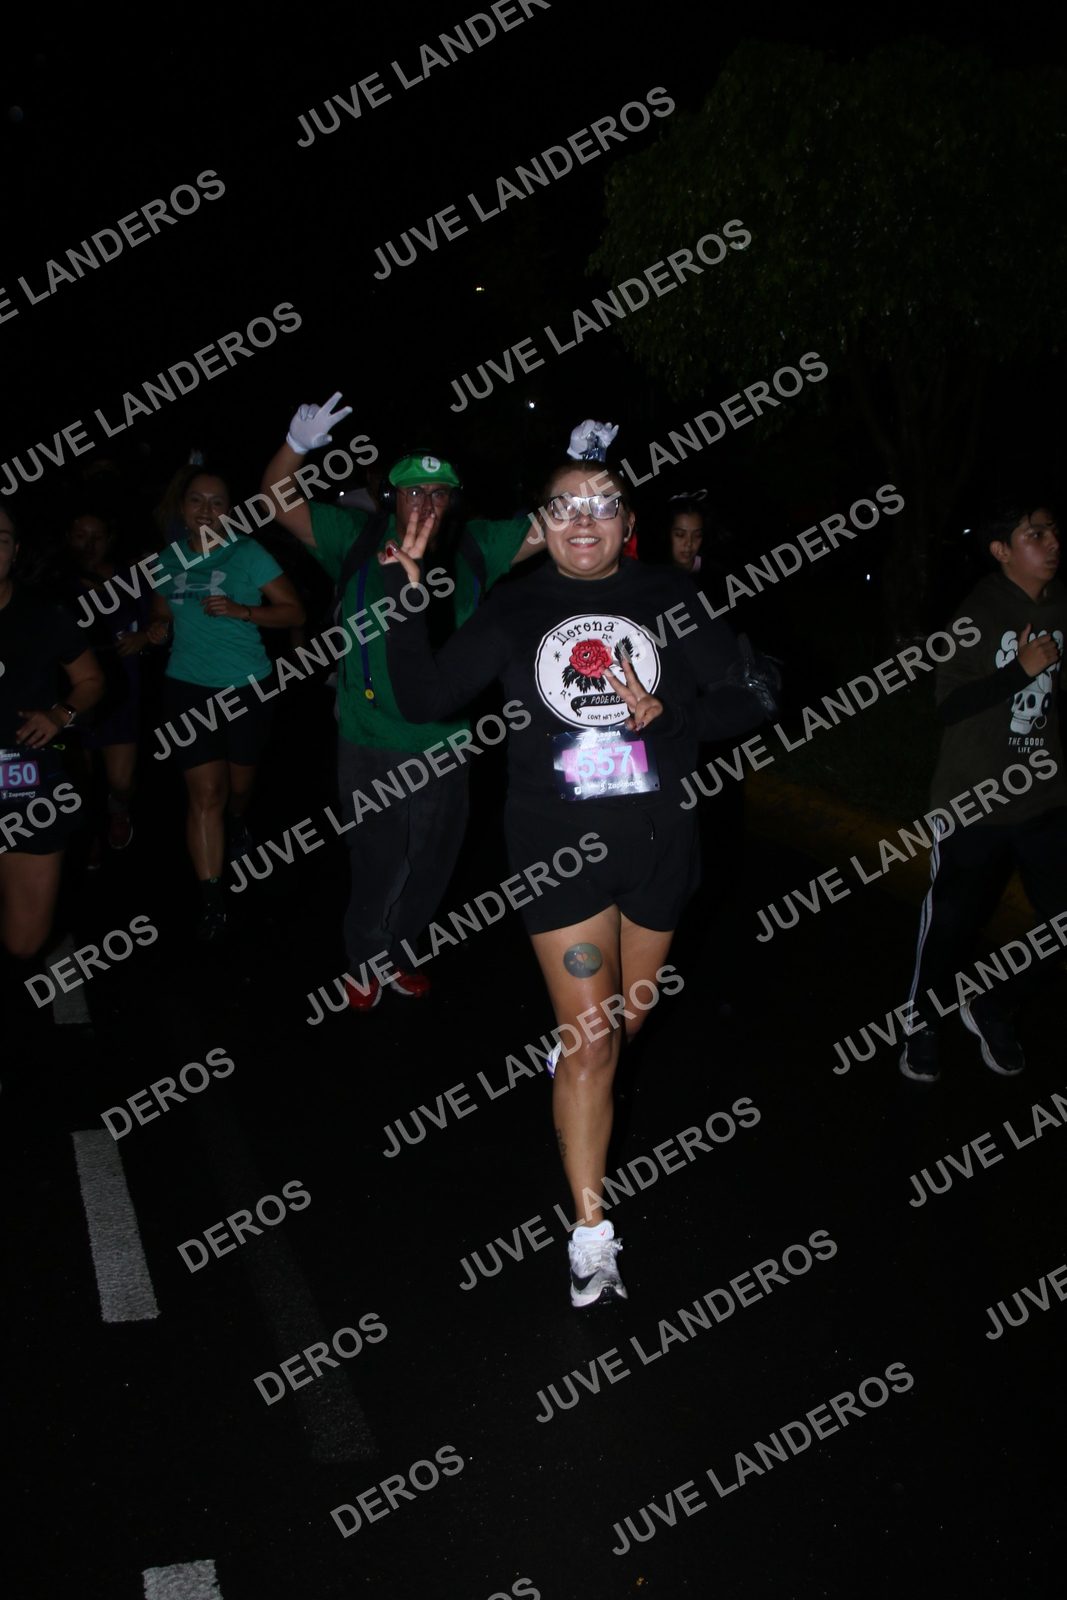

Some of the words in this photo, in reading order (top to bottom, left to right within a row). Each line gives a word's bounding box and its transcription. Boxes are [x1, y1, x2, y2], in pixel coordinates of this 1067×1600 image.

[591, 695, 625, 705] PODERO
[1024, 737, 1044, 746] GOOD
[577, 745, 632, 778] 557
